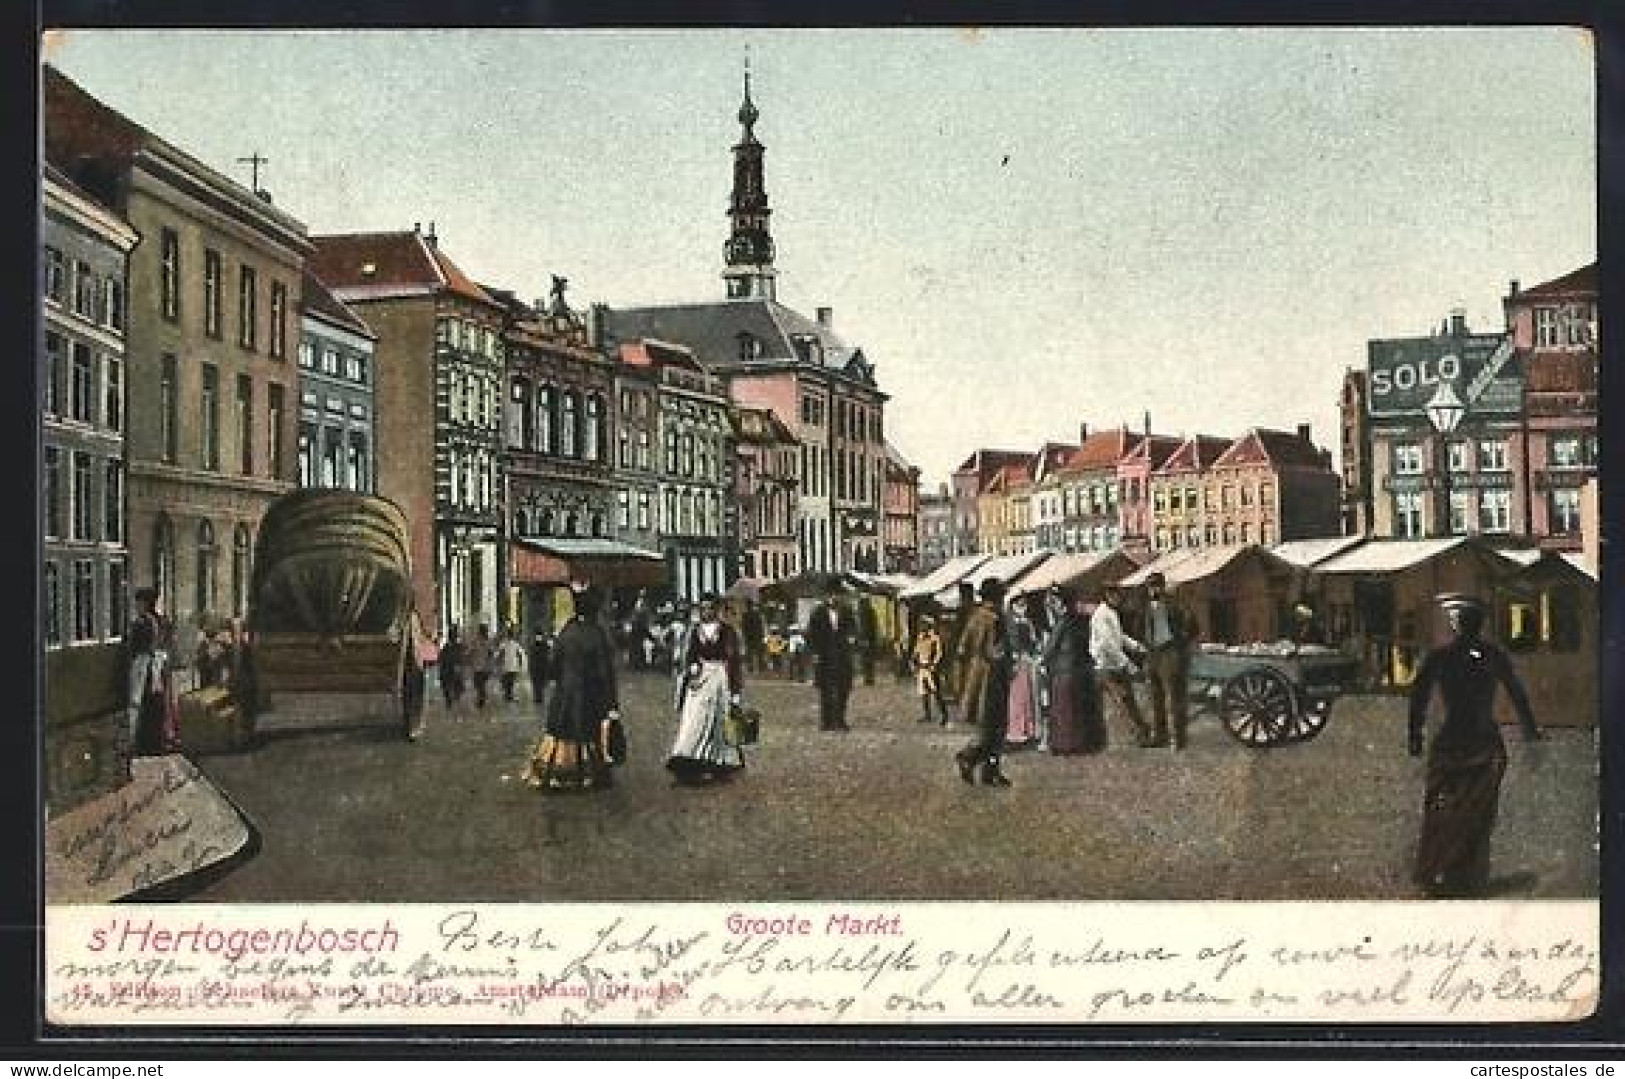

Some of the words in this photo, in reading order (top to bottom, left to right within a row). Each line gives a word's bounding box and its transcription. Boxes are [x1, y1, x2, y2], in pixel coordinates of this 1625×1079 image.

[1373, 355, 1460, 396] SOLO
[87, 919, 400, 961] s'Hertogenbosch
[726, 913, 813, 935] Groote
